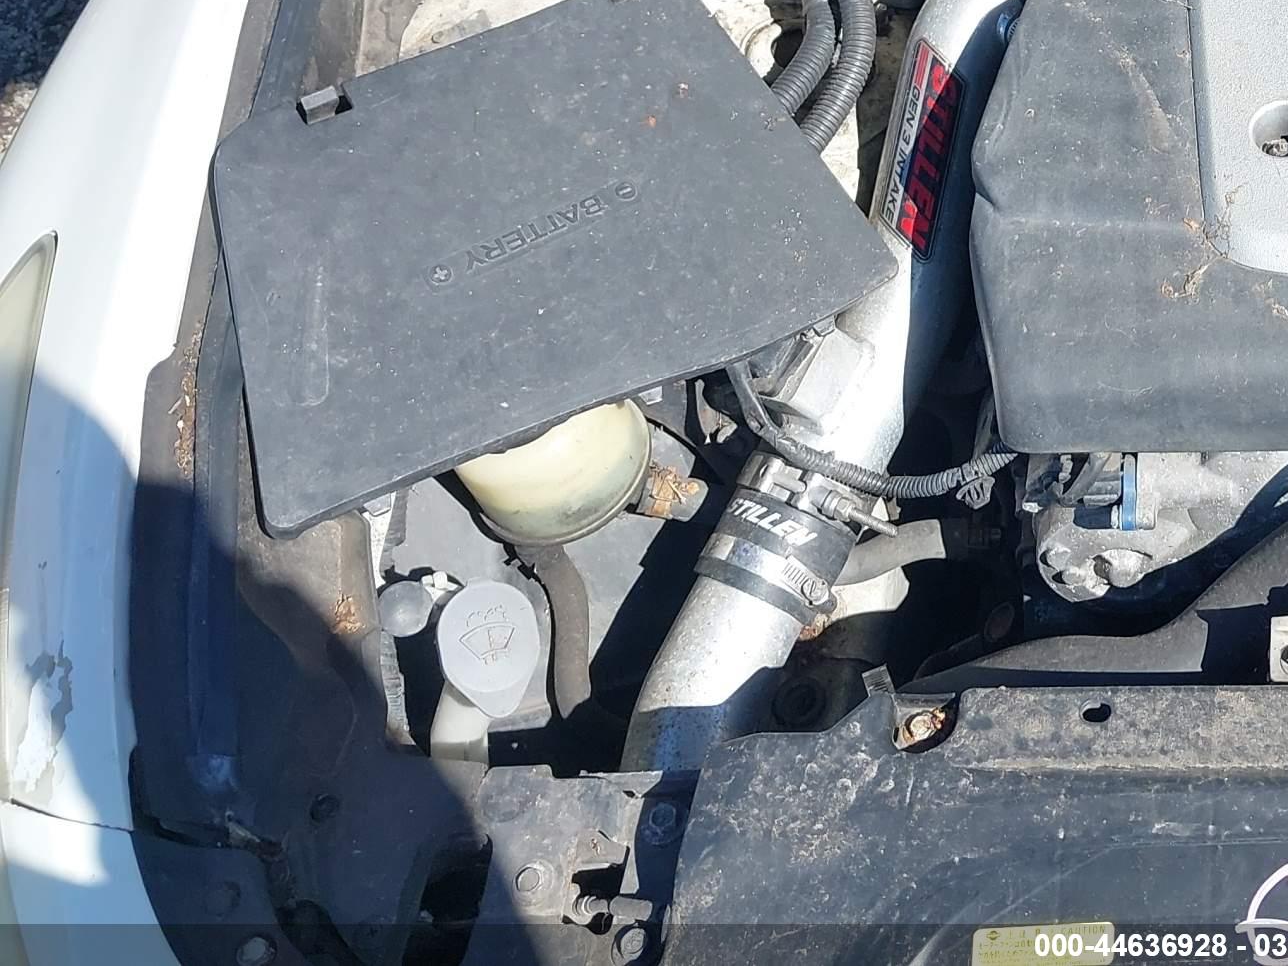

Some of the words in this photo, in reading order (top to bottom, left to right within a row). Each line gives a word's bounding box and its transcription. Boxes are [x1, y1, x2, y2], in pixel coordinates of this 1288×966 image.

[902, 133, 910, 146] 3
[906, 87, 922, 129] GEN
[883, 150, 908, 223] INTAKE
[897, 63, 957, 251] STILLEN
[465, 194, 605, 273] BATTERY
